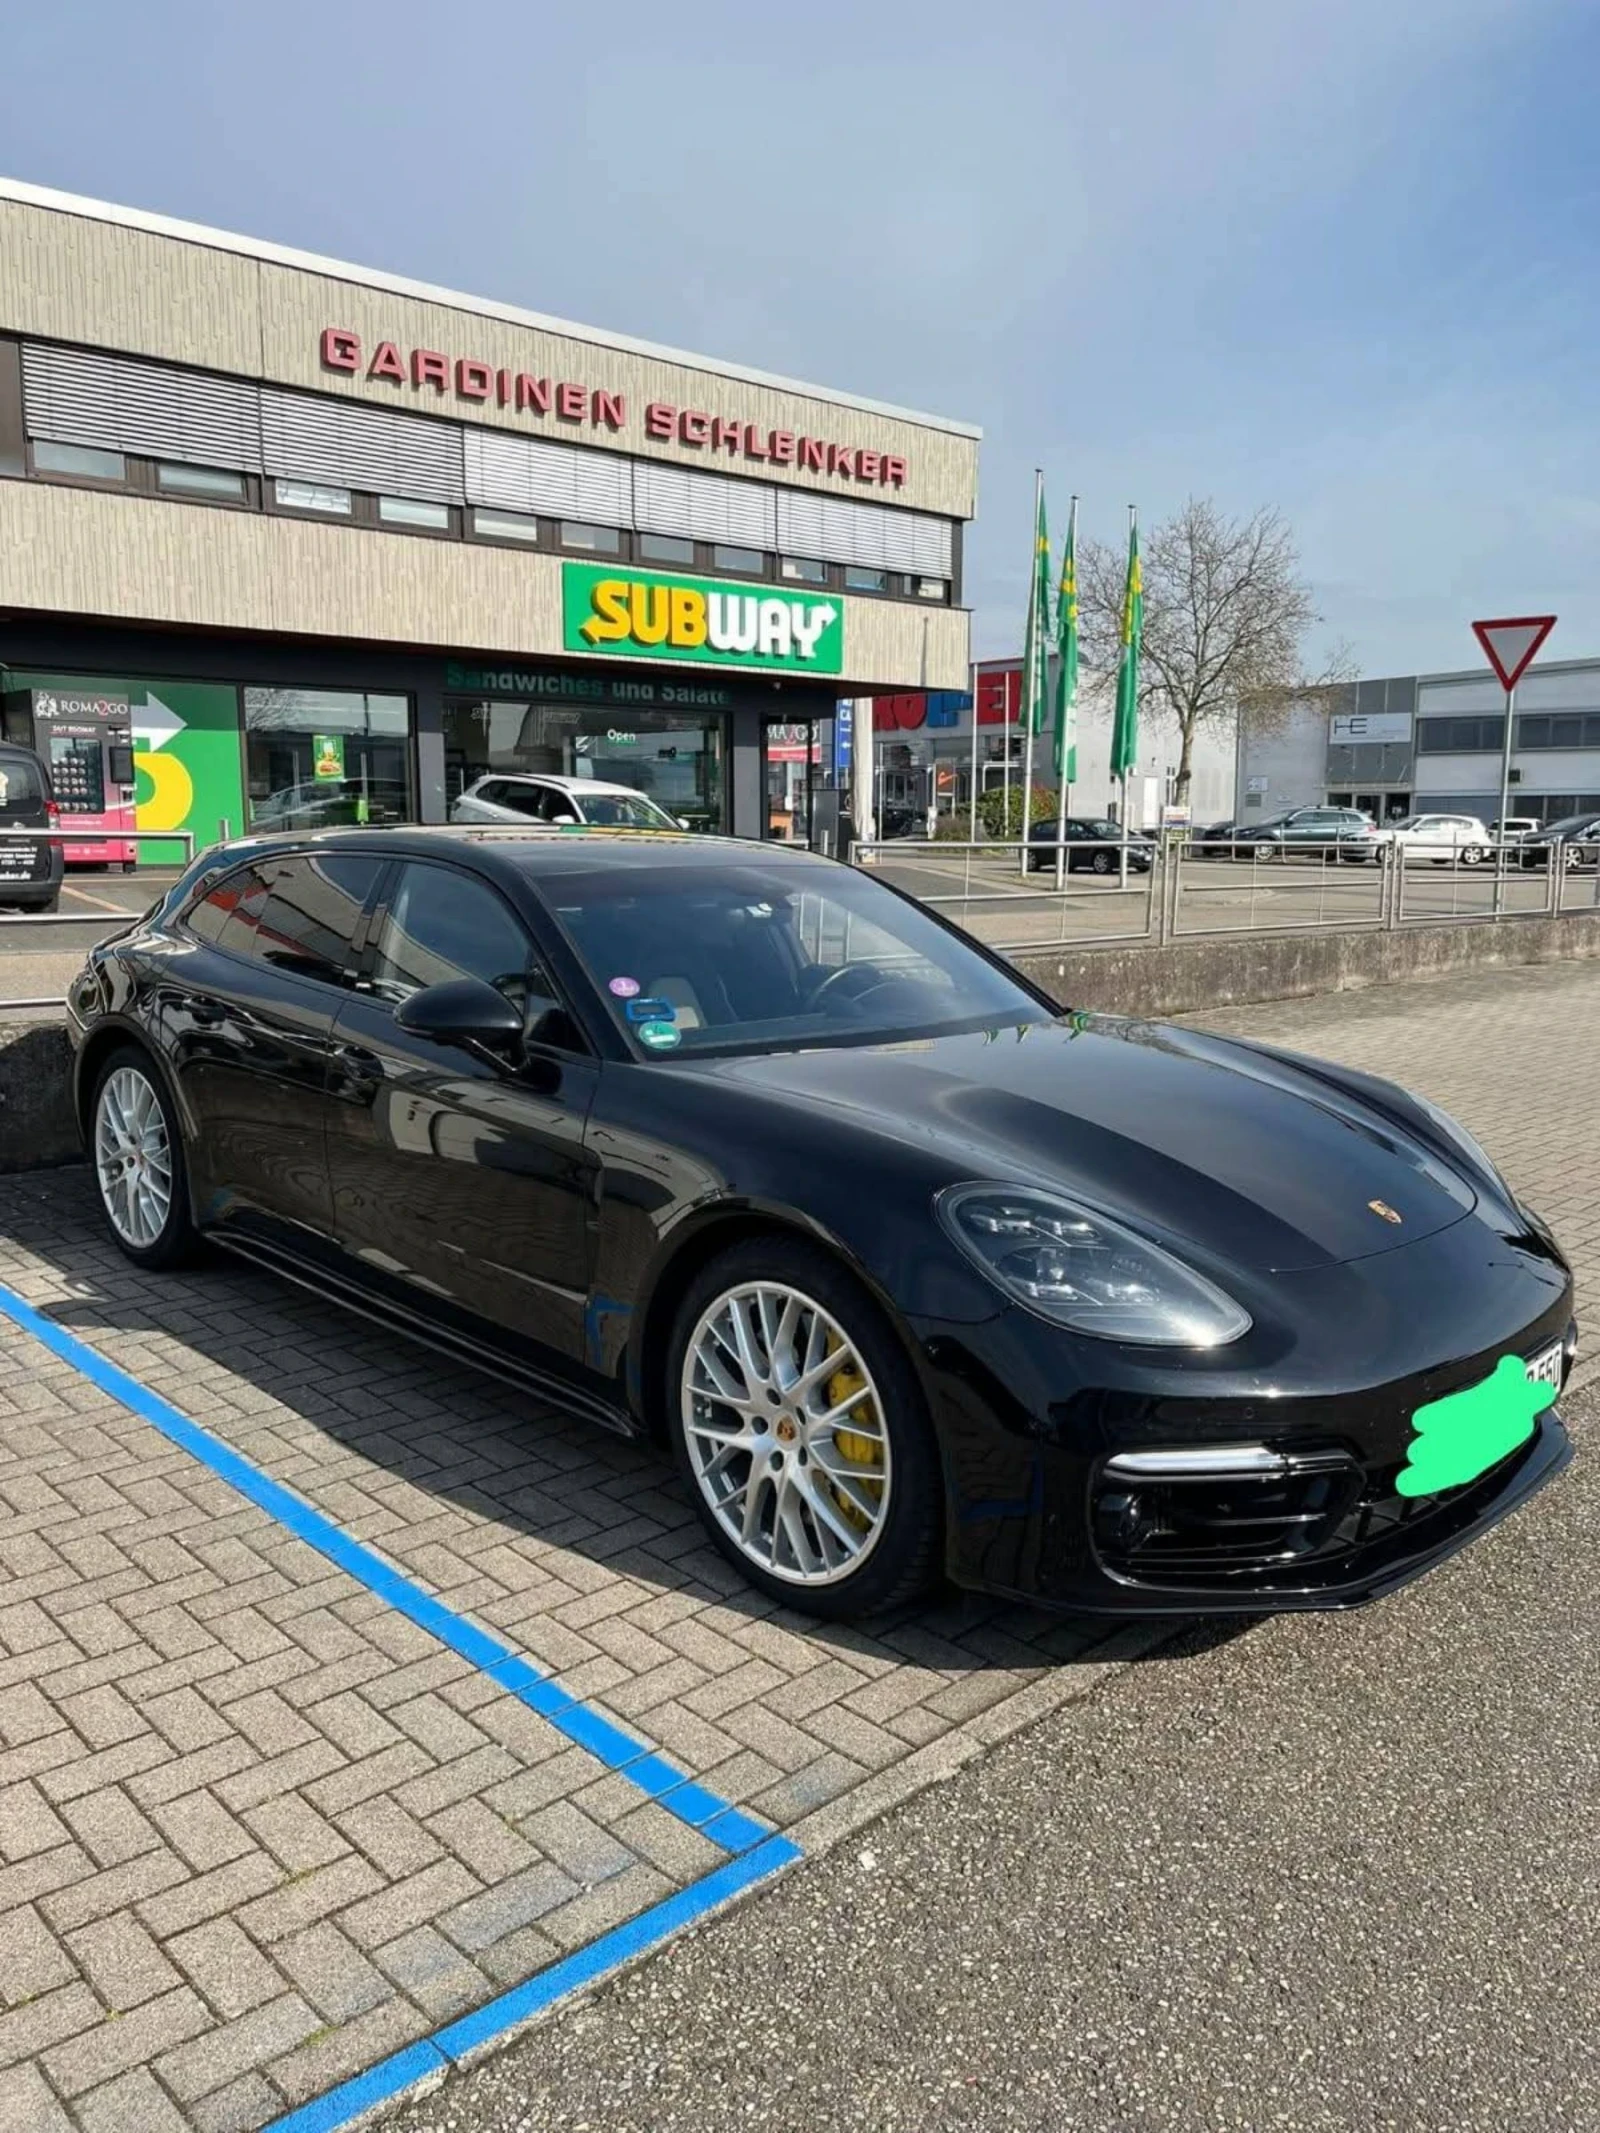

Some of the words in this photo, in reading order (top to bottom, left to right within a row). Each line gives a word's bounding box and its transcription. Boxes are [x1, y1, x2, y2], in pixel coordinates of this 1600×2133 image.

[320, 327, 626, 428] GARDINEN
[646, 403, 908, 487] SCHLENKER
[578, 579, 838, 659] SUBWAY
[447, 662, 603, 698] Sandwiches
[60, 699, 128, 717] ROMA2GO
[606, 727, 637, 744] Open
